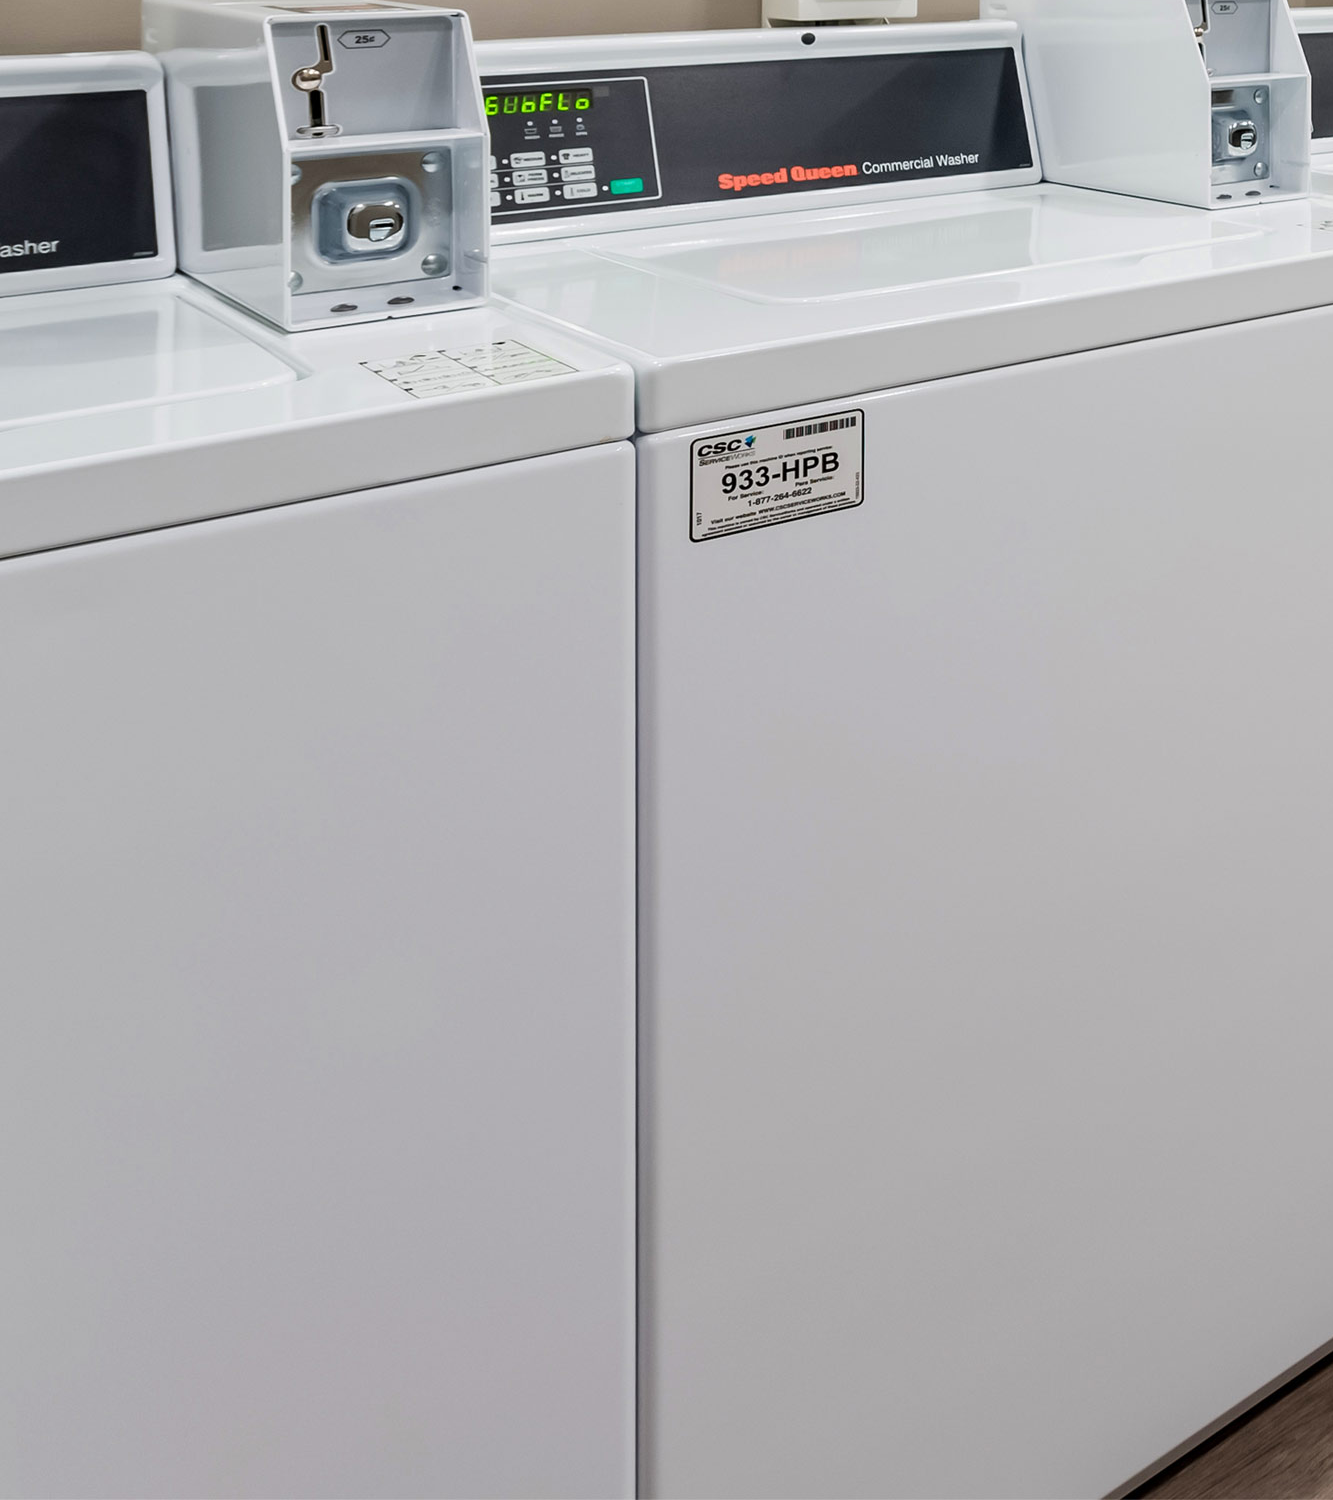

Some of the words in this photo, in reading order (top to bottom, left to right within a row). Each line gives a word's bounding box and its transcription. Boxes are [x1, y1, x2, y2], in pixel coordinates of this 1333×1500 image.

[718, 168, 788, 191] Speed
[790, 164, 858, 182] Queen
[862, 156, 934, 175] Commercial
[935, 152, 979, 167] Washer
[0, 240, 60, 258] asher
[697, 439, 742, 457] CSC
[721, 452, 840, 494] 933-HPB
[748, 487, 812, 507] 1-877-264-6622
